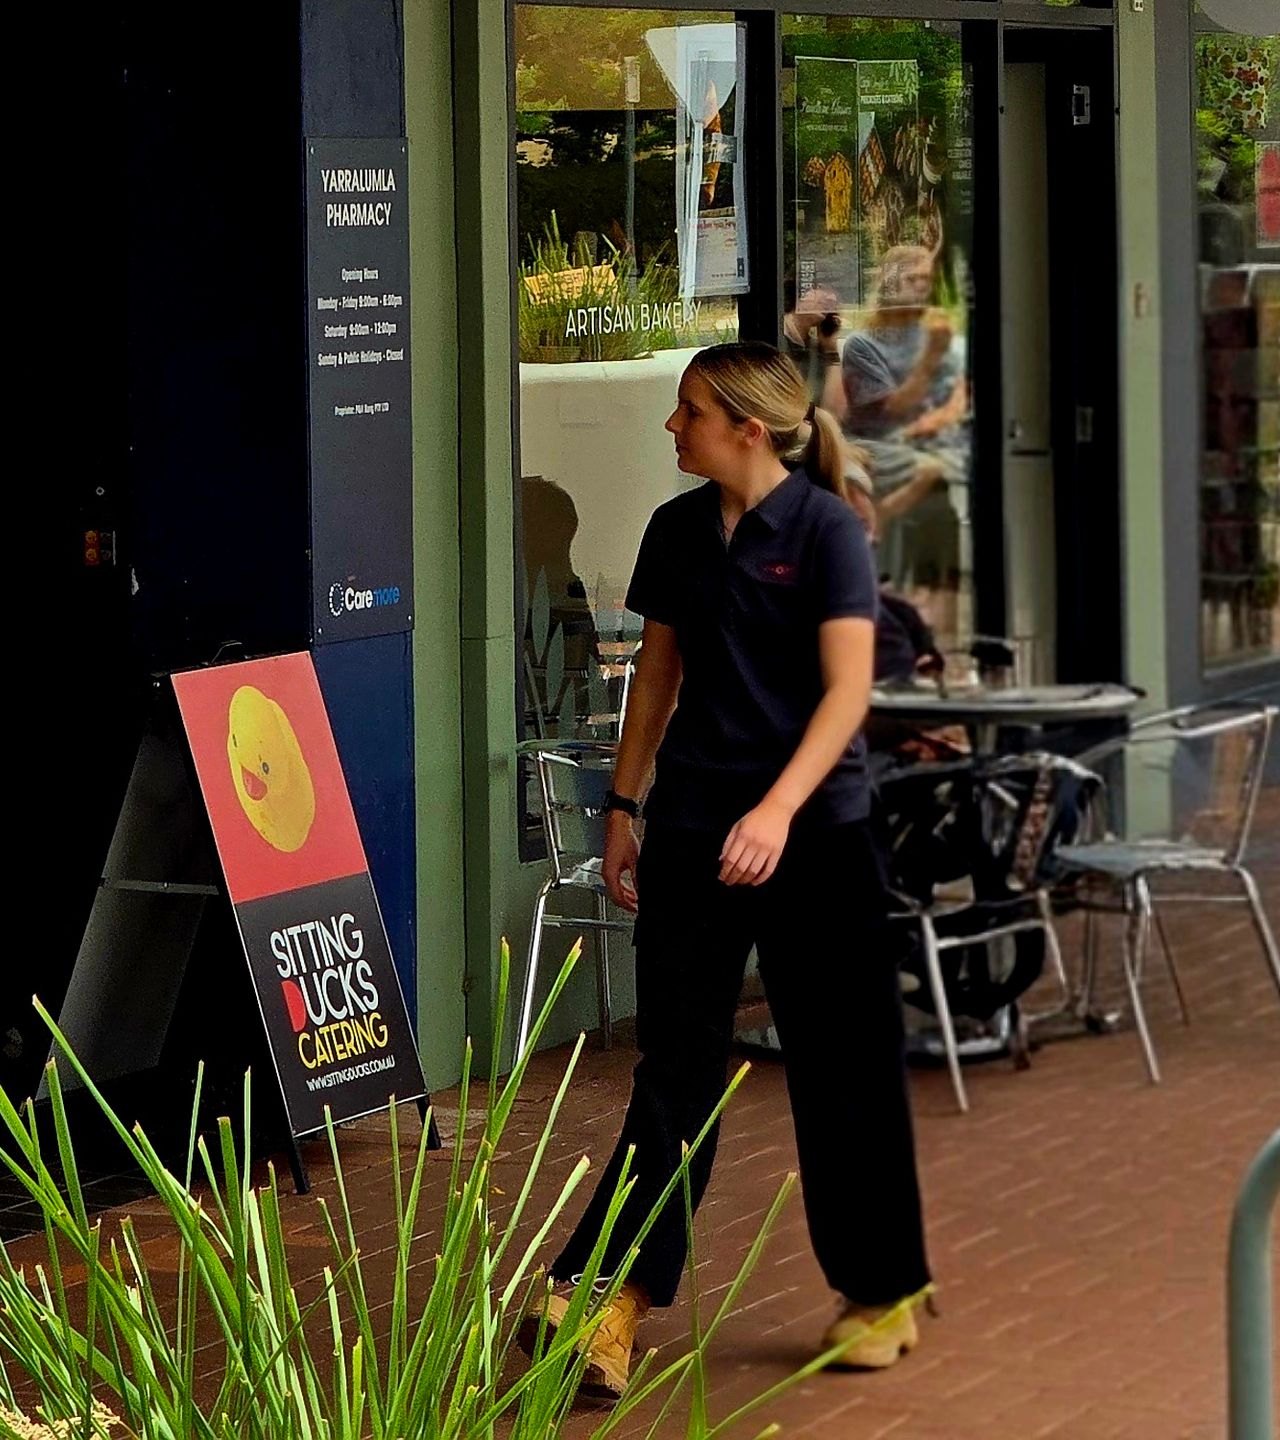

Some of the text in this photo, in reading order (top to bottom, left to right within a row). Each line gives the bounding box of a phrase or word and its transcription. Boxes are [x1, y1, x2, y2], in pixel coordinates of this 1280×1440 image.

[321, 168, 396, 193] YARRALUMLA
[326, 203, 392, 227] PHARMACY
[342, 267, 379, 283] Opening Hours
[317, 296, 338, 312] Monday
[342, 295, 358, 311] Friday
[324, 324, 348, 339] Saturday
[565, 301, 702, 338] ARTISAN BAKERY
[318, 353, 338, 368] Sunday
[343, 351, 360, 365] Public
[386, 347, 404, 361] Closed
[344, 586, 400, 611] Caremore
[270, 913, 364, 979] SITTING
[281, 959, 380, 1033] DUCKS
[298, 1012, 389, 1070] CATERING
